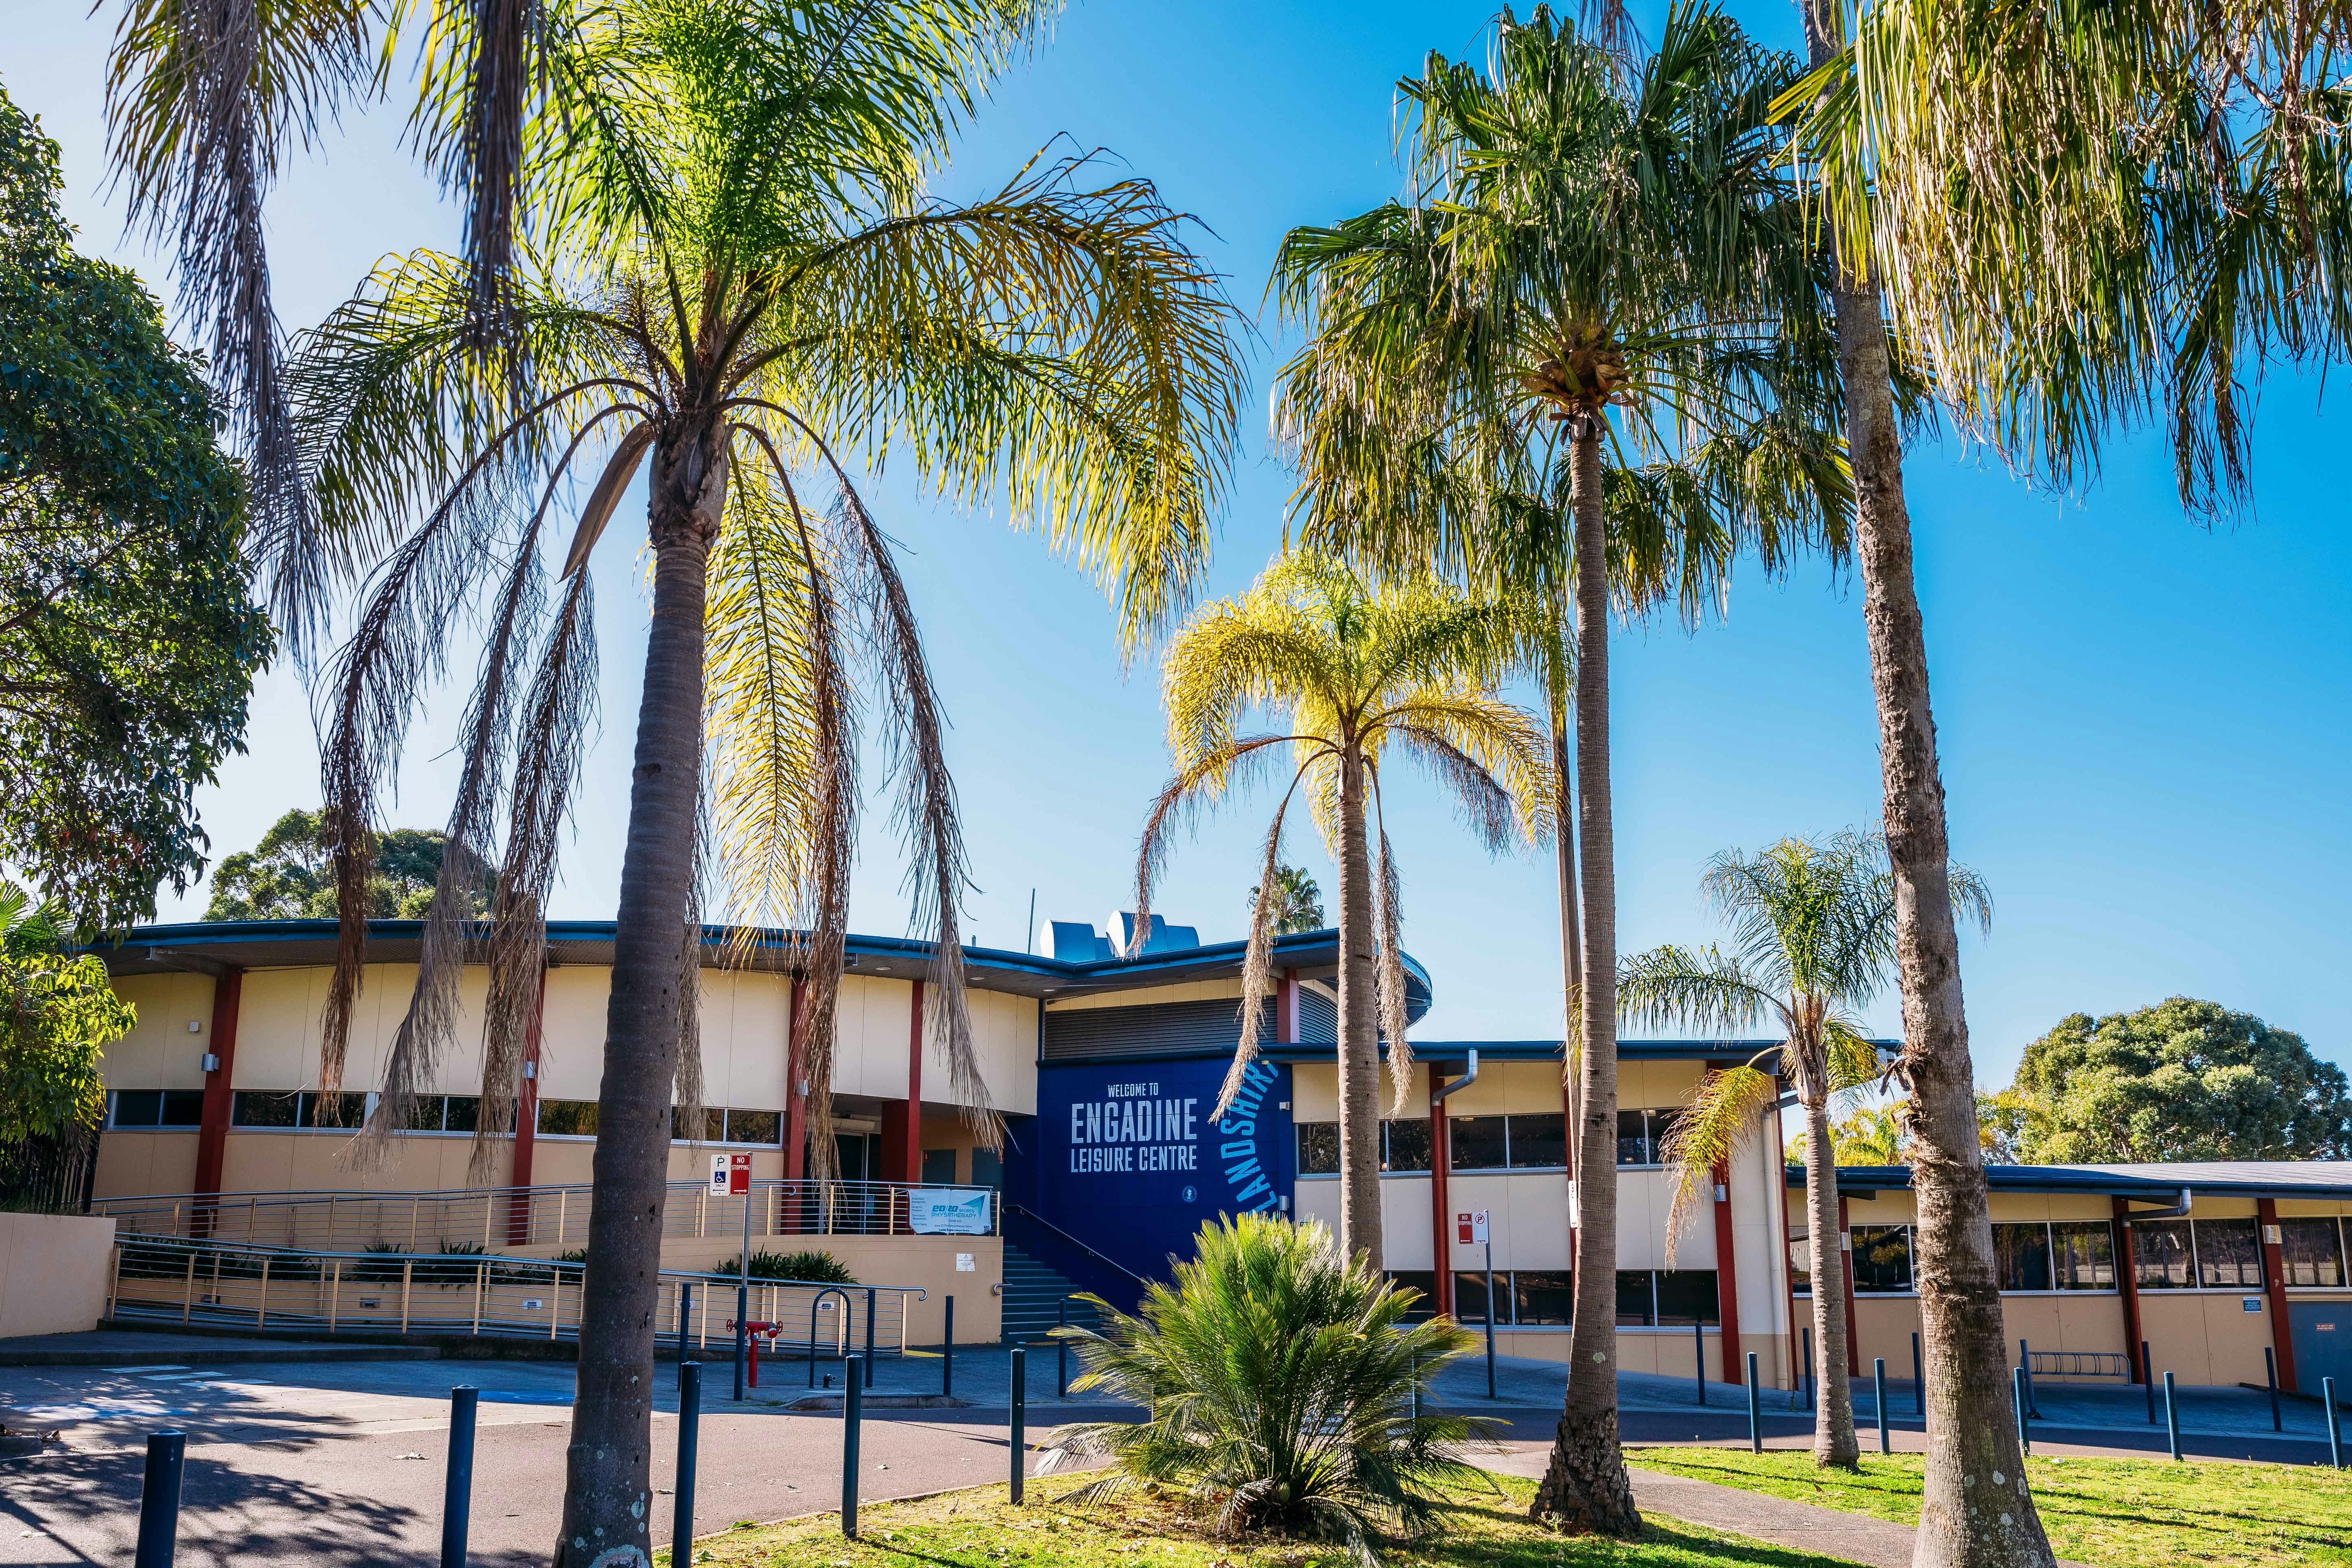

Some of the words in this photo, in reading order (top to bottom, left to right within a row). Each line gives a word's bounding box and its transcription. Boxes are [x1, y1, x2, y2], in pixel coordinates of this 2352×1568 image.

[1108, 1083, 1146, 1097] WELCOME
[1149, 1083, 1158, 1095] TO
[1072, 1098, 1197, 1144] ENGADINE
[717, 1157, 725, 1167] P
[1071, 1147, 1133, 1172] LEISURE
[1139, 1145, 1197, 1171] CENTRE
